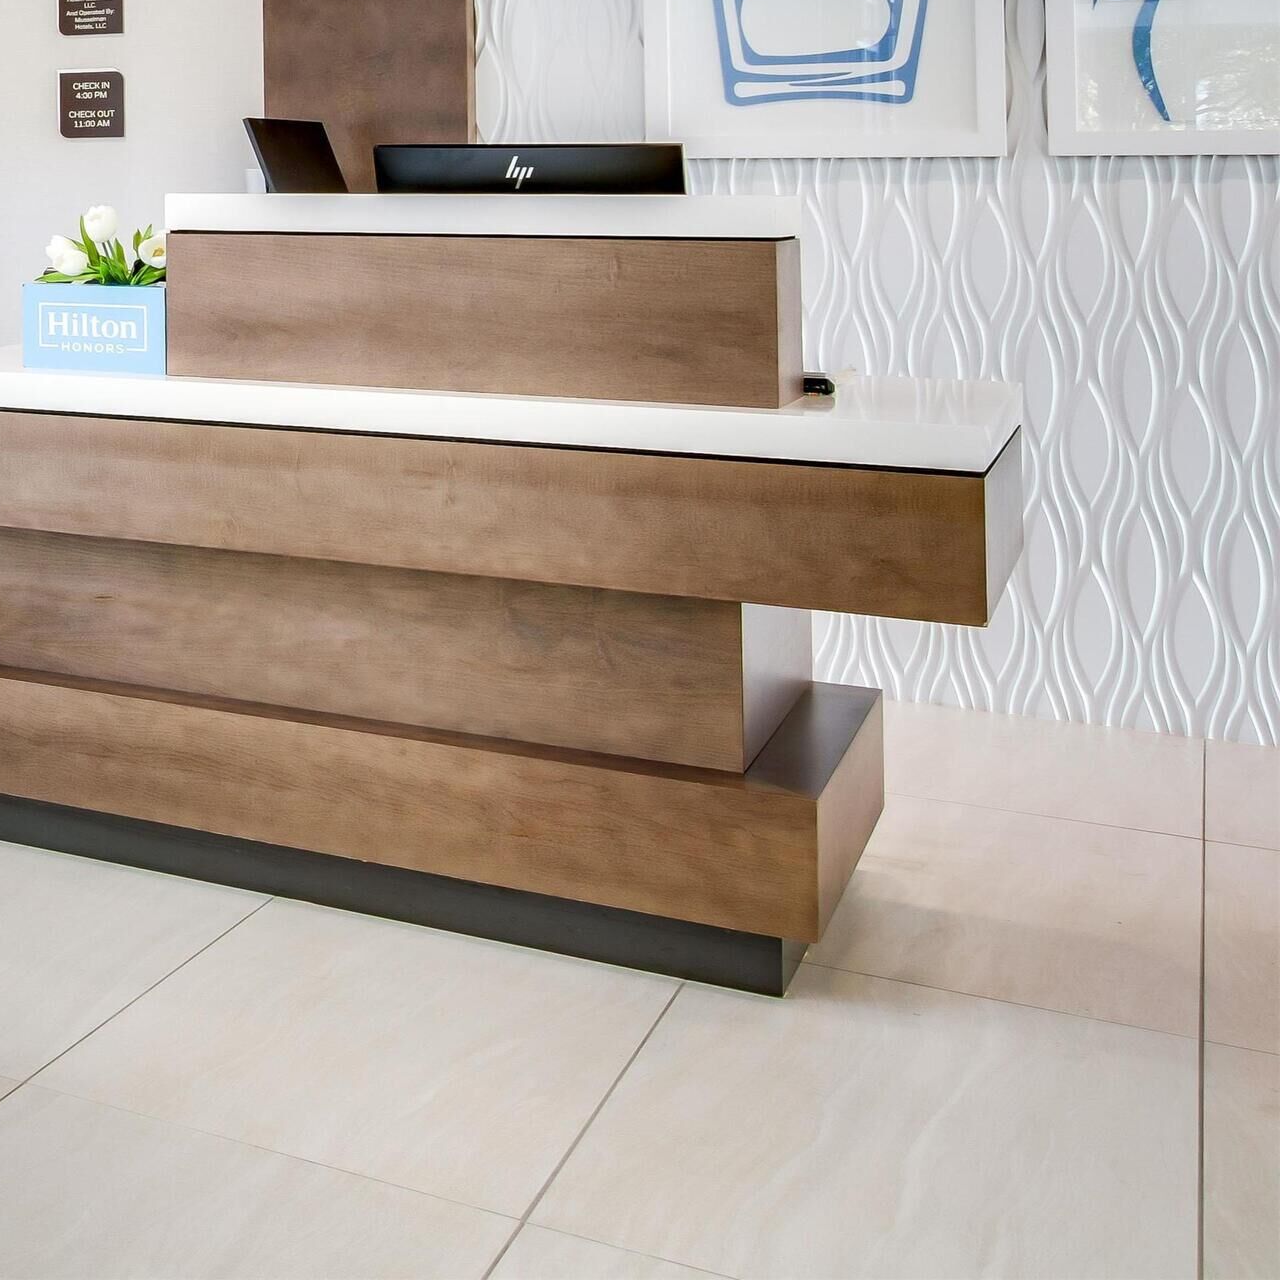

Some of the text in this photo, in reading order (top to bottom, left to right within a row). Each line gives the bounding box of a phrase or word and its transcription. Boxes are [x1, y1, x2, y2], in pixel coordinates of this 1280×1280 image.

[73, 81, 110, 90] CHECK IN
[94, 91, 108, 99] PM
[68, 109, 115, 118] CHECK OUT
[74, 119, 110, 128] 11:00 AM
[505, 155, 534, 189] hp
[47, 311, 138, 339] Hilton
[61, 342, 125, 354] HONORS
